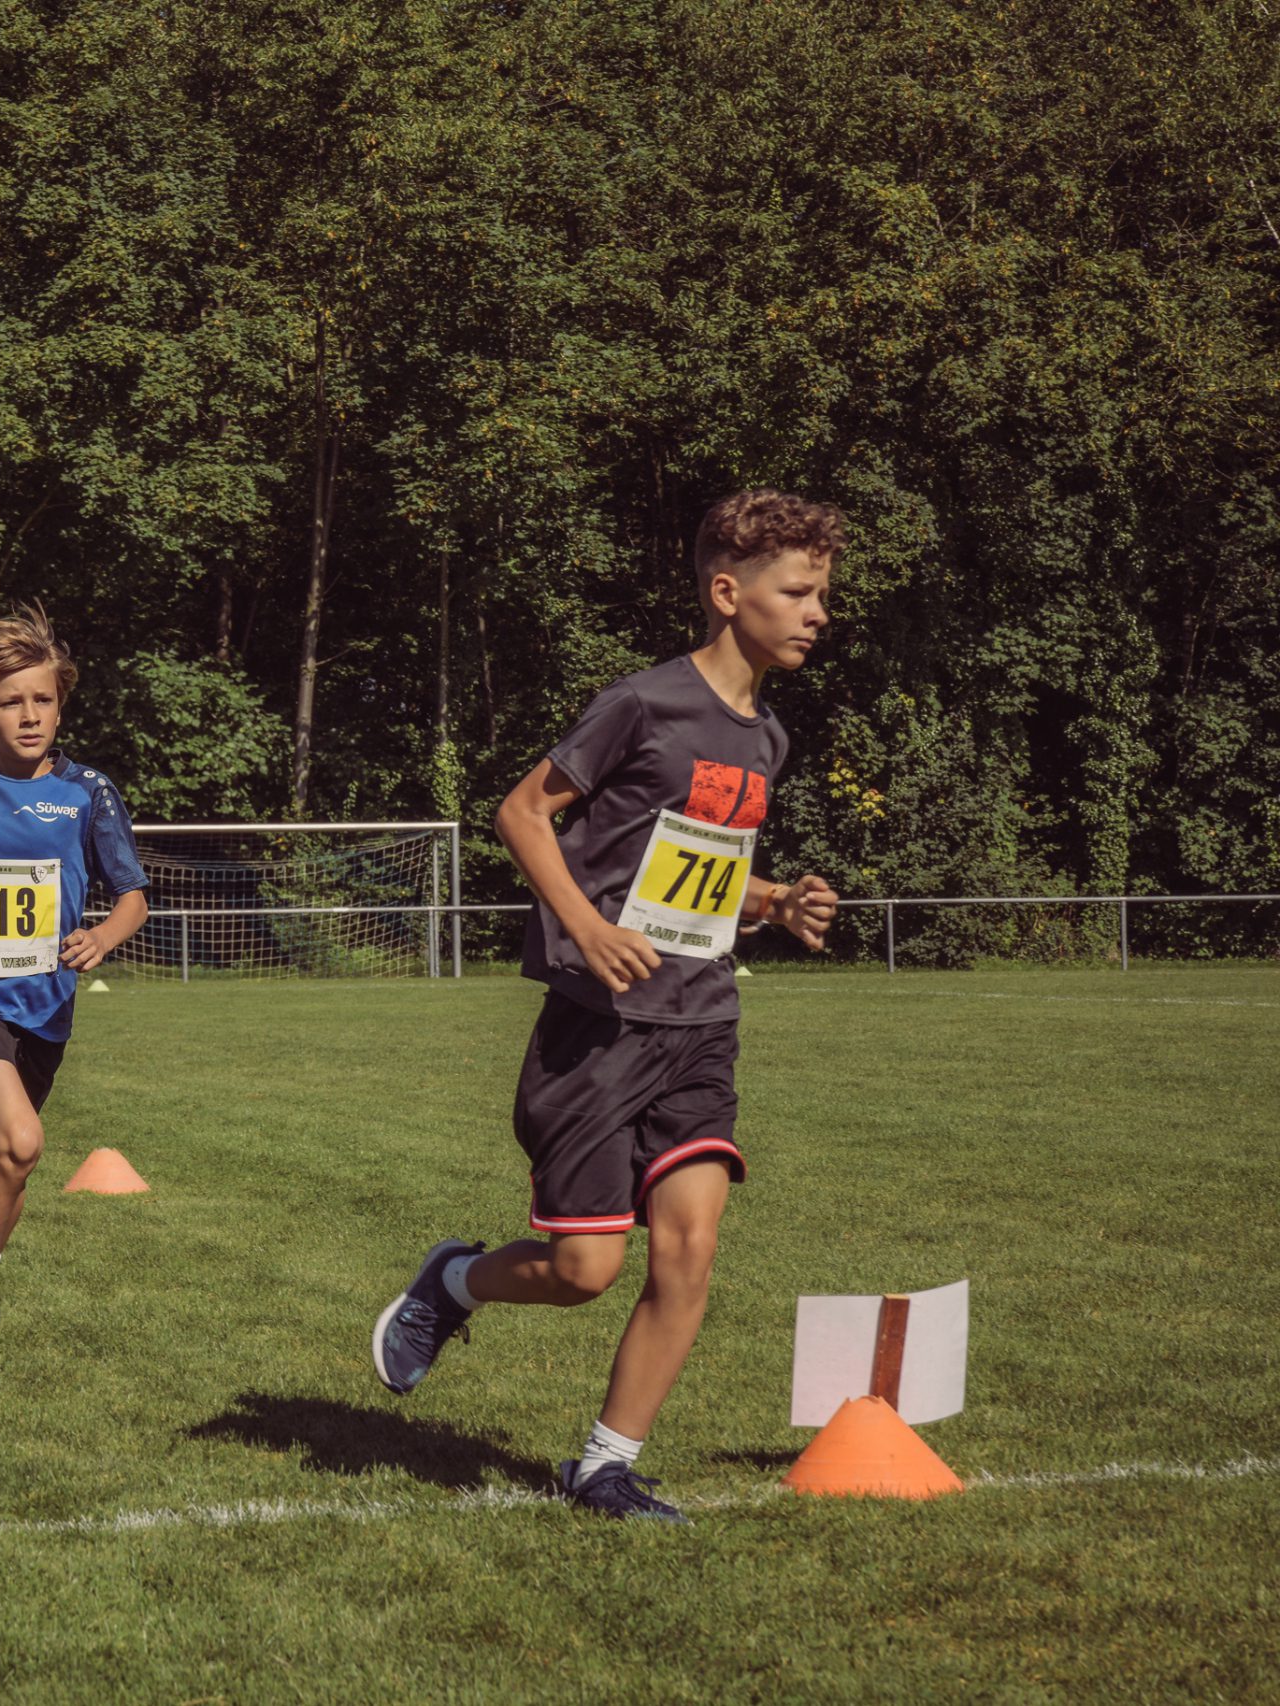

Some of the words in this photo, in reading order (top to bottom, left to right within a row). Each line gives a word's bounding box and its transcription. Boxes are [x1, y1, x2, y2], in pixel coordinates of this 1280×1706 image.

[35, 801, 79, 819] Süwag
[662, 849, 737, 912] 714
[643, 923, 679, 942] LAUF
[1, 955, 37, 969] WEISE
